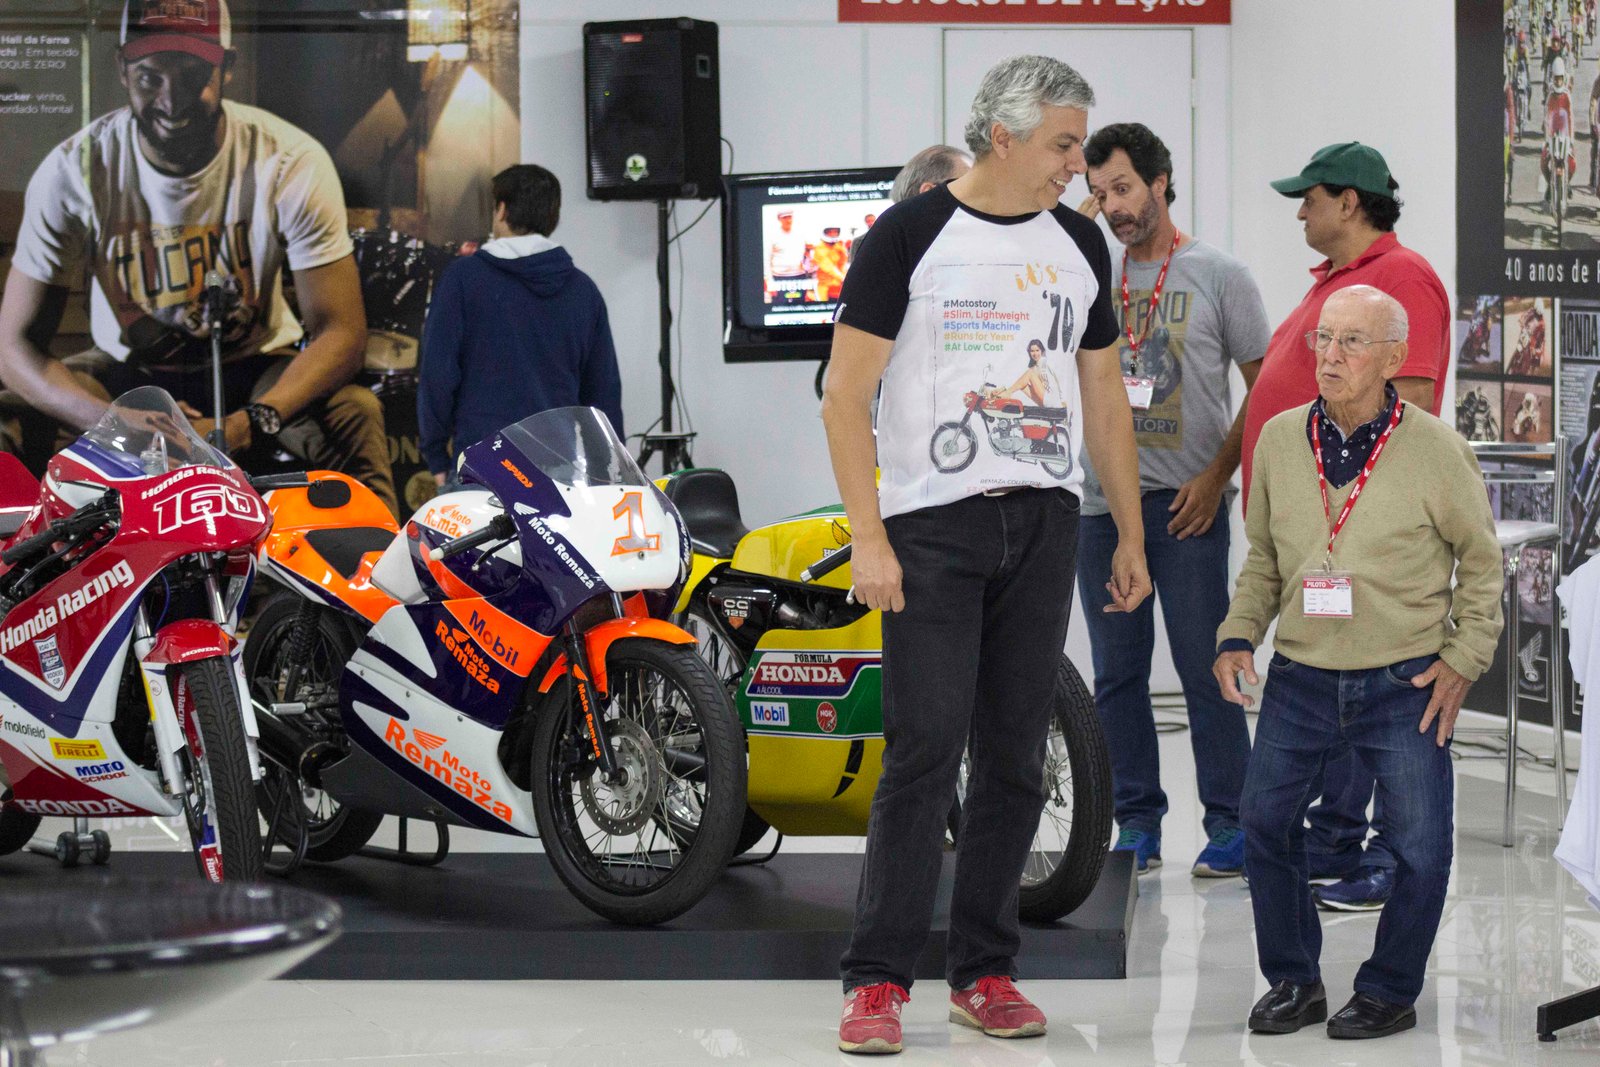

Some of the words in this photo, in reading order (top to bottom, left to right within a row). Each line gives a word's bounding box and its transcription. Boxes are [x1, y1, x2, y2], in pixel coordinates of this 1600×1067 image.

[1505, 257, 1521, 281] 40
[1529, 263, 1564, 283] anos
[1571, 258, 1590, 283] de
[944, 299, 997, 310] #Motostory
[975, 310, 1030, 322] Lightweight
[944, 321, 980, 331] #Sports
[982, 322, 1021, 331] Machine
[944, 342, 960, 351] #At
[963, 343, 981, 351] Low
[983, 343, 1004, 352] Cost
[141, 469, 194, 500] Honda
[196, 466, 241, 488] Racing
[153, 483, 266, 535] 160
[611, 492, 660, 557] 1
[528, 516, 555, 545] Moto
[553, 543, 595, 589] Remaza
[0, 606, 58, 654] Honda
[57, 559, 135, 620] Racing
[725, 609, 748, 618] 125
[469, 609, 519, 667] Mobil
[181, 646, 222, 658] HONDA
[435, 619, 500, 694] Remaza
[464, 643, 490, 673] Moto
[760, 665, 846, 683] HONDA
[577, 683, 589, 712] Moto
[585, 713, 601, 758] Remaza
[754, 705, 785, 722] Mobil
[4, 720, 46, 739] motofield
[54, 741, 100, 757] PIRELLI
[75, 760, 125, 777] MOTO
[80, 771, 130, 784] SCHOOL
[384, 716, 513, 823] Remaza
[442, 750, 492, 791] Moto
[14, 799, 136, 814] HONDA
